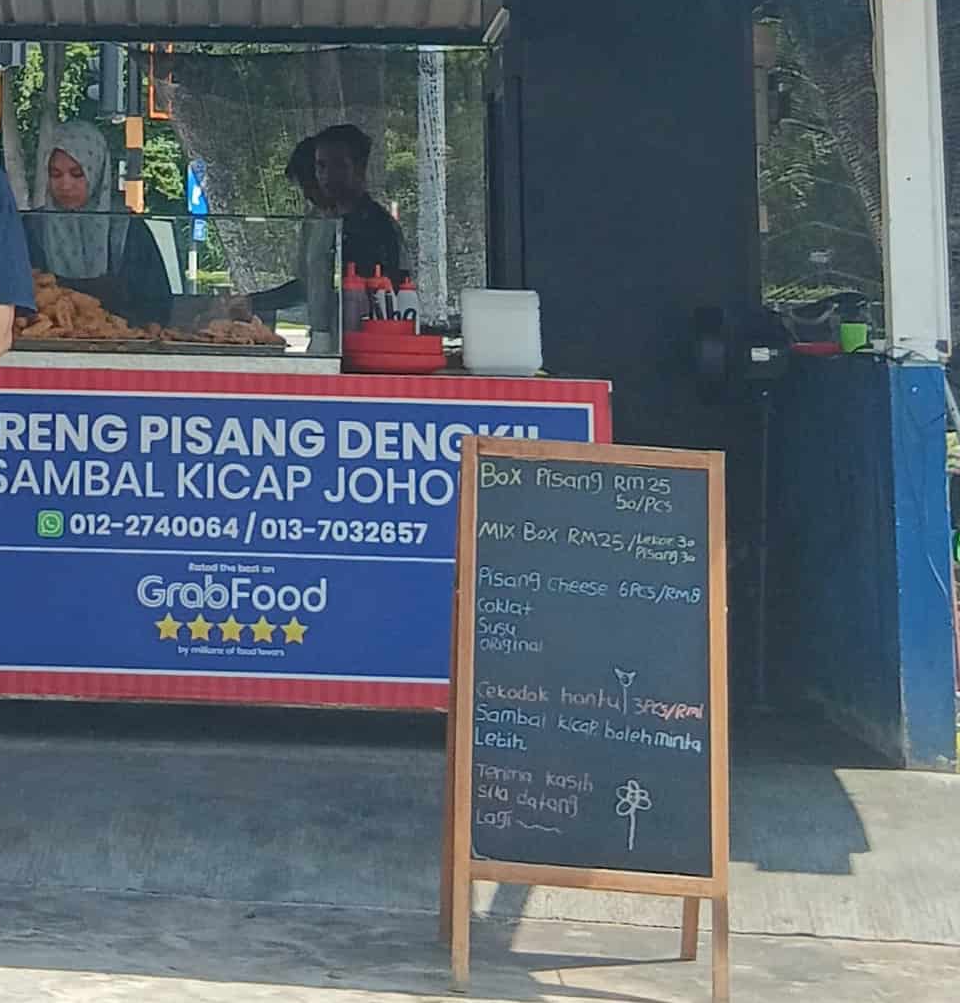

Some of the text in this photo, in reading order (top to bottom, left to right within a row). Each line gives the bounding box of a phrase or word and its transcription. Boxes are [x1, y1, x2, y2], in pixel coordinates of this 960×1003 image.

[140, 415, 326, 458] PISANG
[338, 420, 539, 462] DENG
[177, 461, 313, 502] KICAP
[323, 465, 461, 506] JOHO
[536, 467, 603, 494] Pisang
[69, 513, 239, 539] 012-2740064
[261, 518, 429, 544] 013-7032657
[137, 574, 327, 613] GrabFood
[478, 566, 542, 593] Pisang
[475, 702, 547, 728] Sambal
